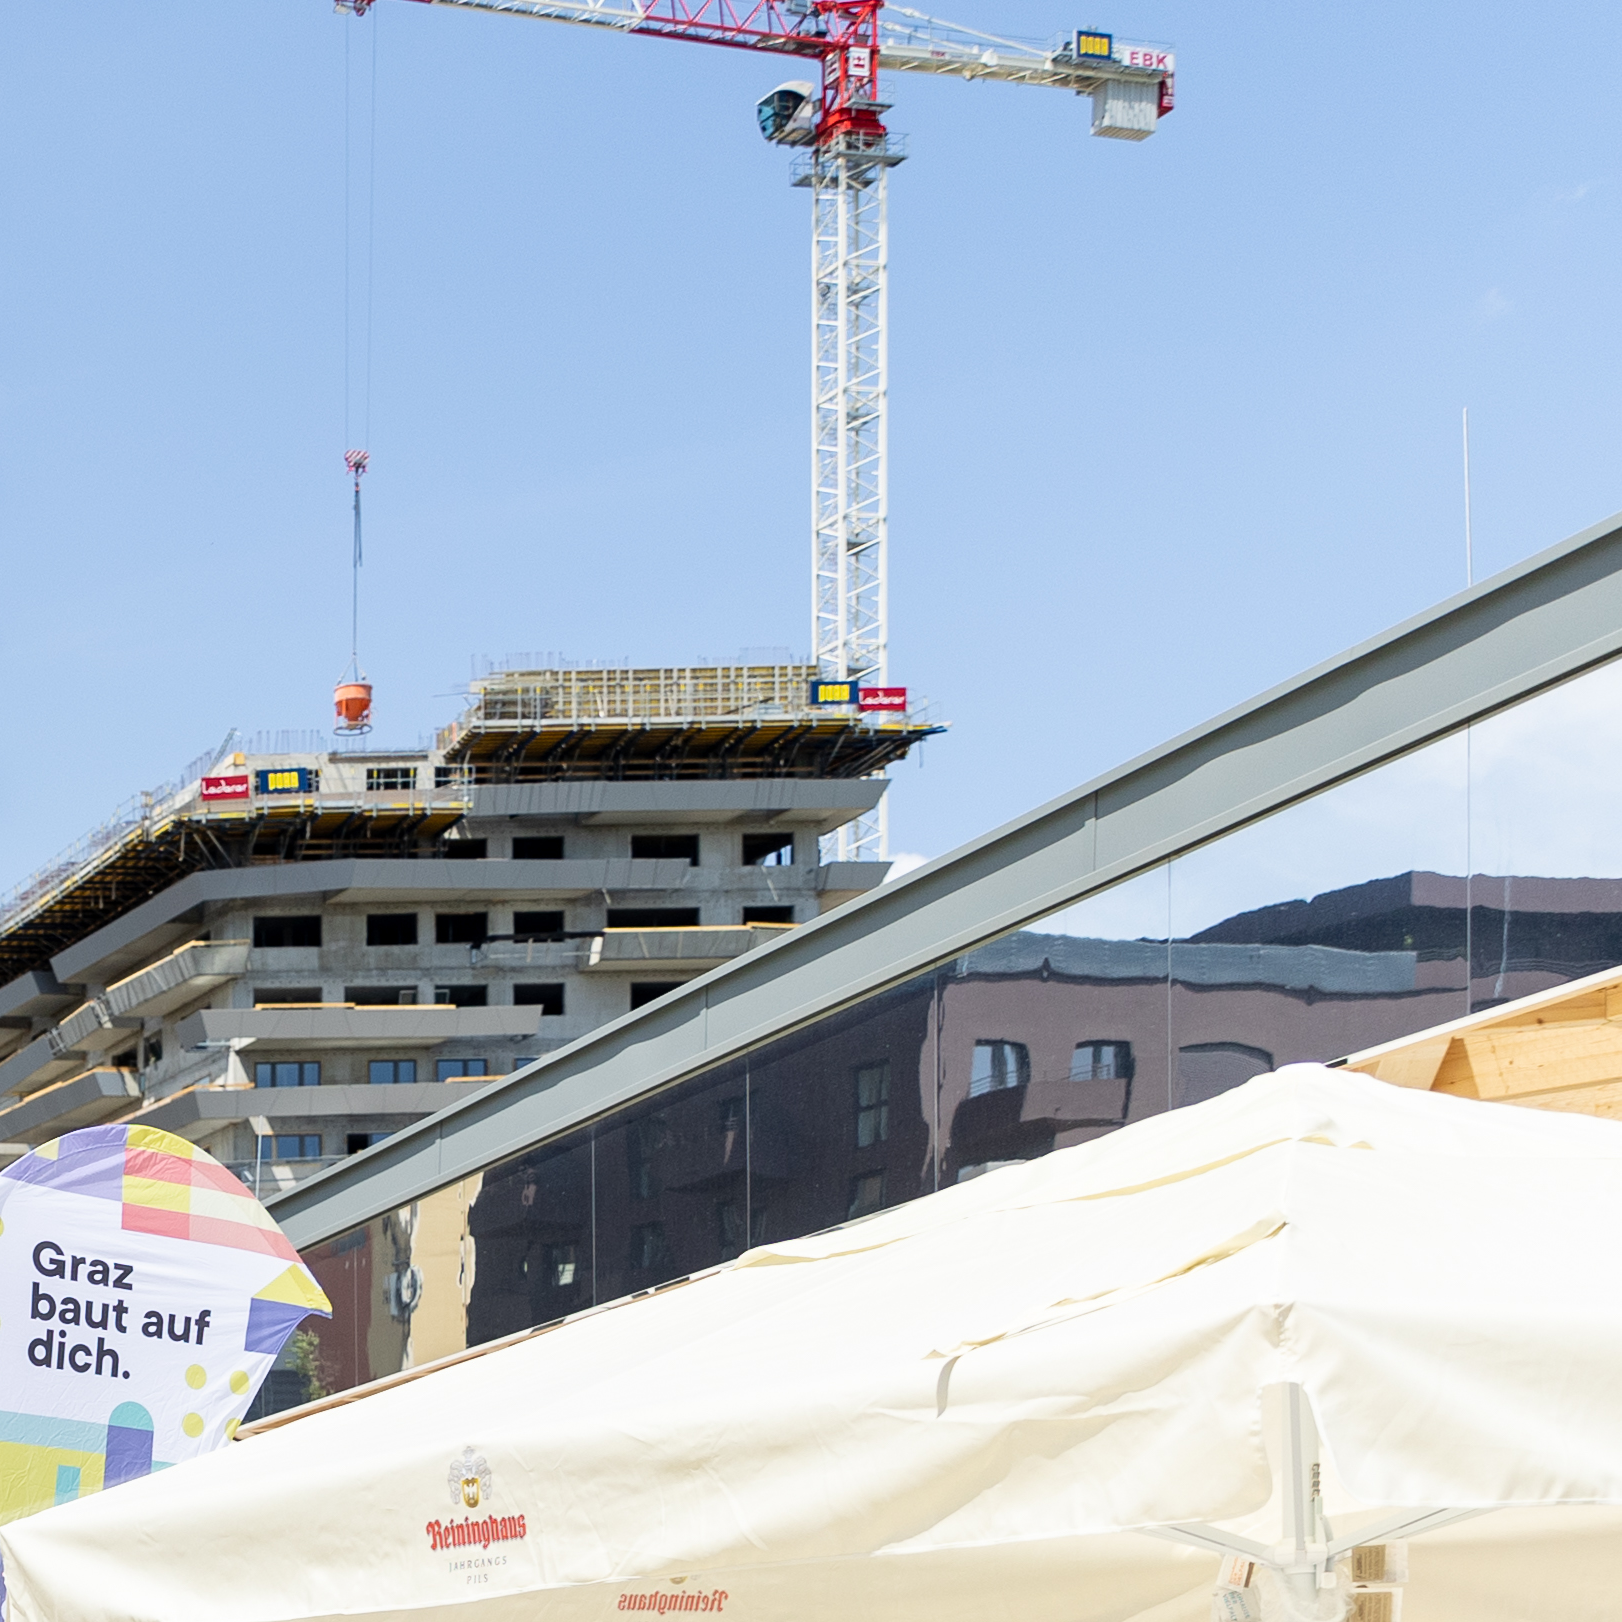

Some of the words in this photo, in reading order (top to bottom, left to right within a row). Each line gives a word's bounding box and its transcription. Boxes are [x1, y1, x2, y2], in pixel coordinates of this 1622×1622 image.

[1129, 51, 1168, 69] EBK
[32, 1240, 134, 1291] Graz
[30, 1281, 129, 1334] baut
[141, 1309, 212, 1345] auf
[27, 1328, 131, 1380] dich.
[426, 1513, 527, 1551] Reininghaus
[449, 1555, 507, 1573] JAHRGANGS
[466, 1573, 489, 1585] PILS
